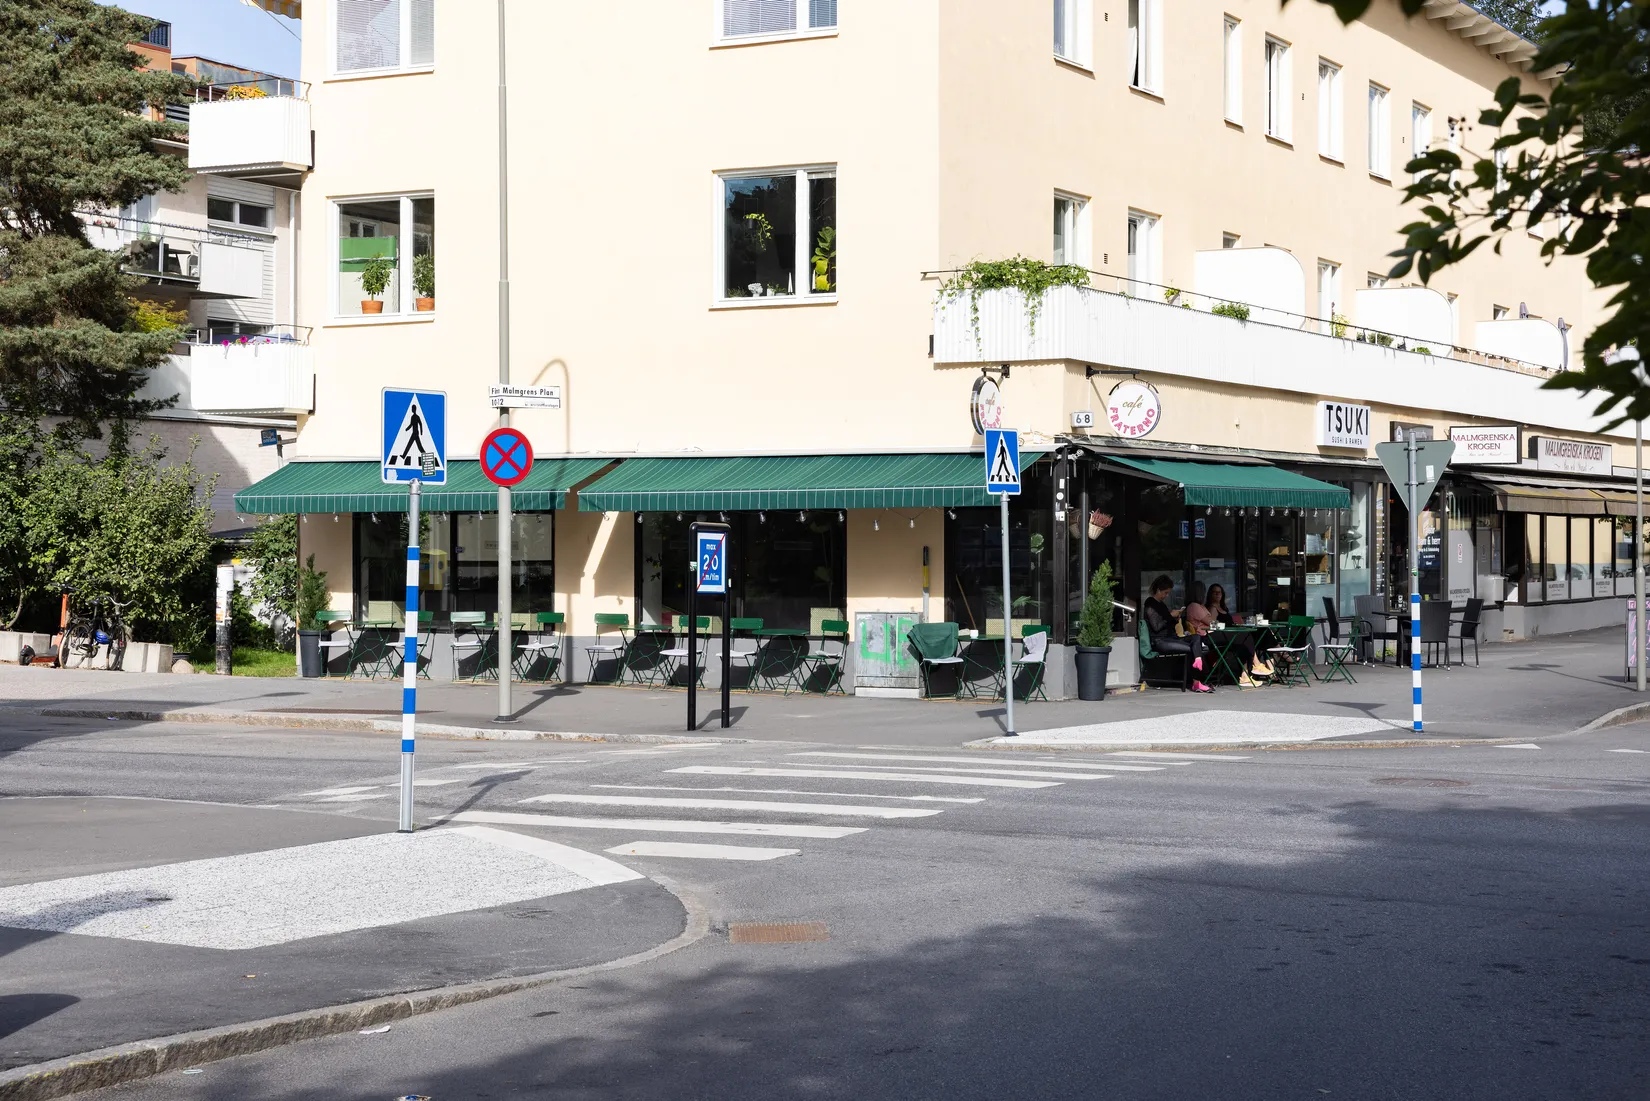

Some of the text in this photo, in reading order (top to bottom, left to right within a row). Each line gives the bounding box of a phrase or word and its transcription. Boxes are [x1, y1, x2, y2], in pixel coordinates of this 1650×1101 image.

[540, 388, 554, 396] Plan
[1122, 395, 1144, 416] café
[1110, 407, 1156, 435] FRATERNO
[1326, 405, 1369, 436] TSUKI
[1452, 433, 1516, 441] MALMGRENSKA
[1467, 442, 1501, 450] KROGEN
[1545, 441, 1604, 460] MALMGRENSKA KROGEN
[703, 554, 719, 570] 20
